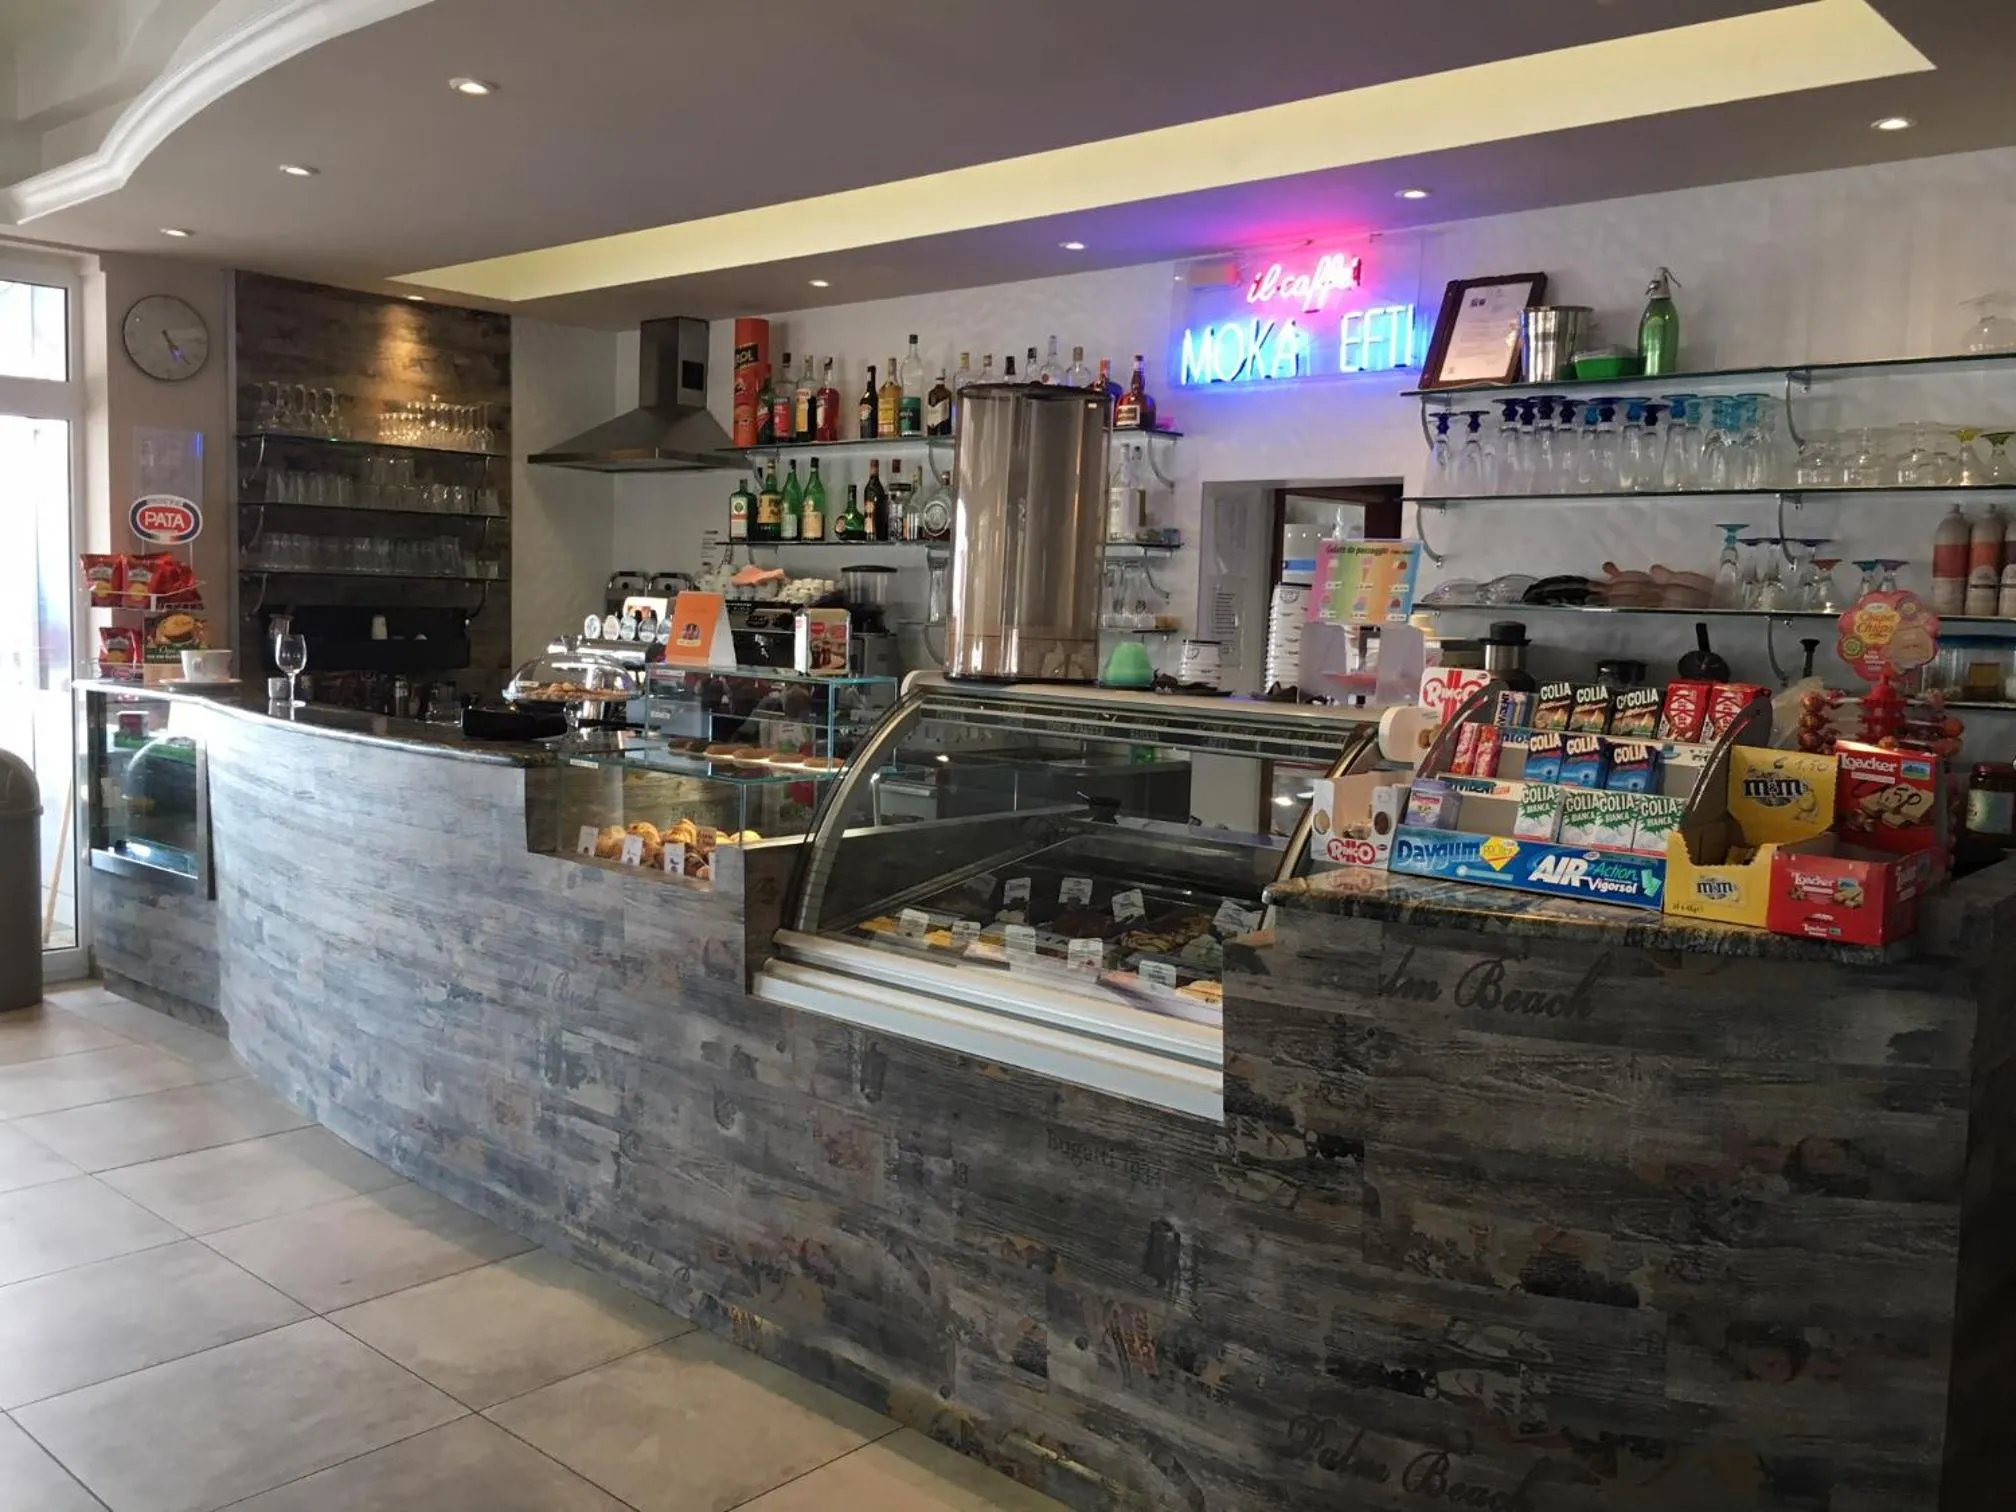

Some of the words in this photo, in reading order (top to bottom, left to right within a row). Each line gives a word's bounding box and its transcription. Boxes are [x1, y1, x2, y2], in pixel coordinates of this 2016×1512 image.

[1181, 318, 1302, 386] MOKA
[1339, 303, 1416, 373] EFTI
[144, 511, 186, 530] PATA
[1837, 752, 1898, 773] Loacker
[1397, 839, 1481, 870] Daygum
[1527, 854, 1588, 888] AIR
[1592, 861, 1638, 881] Action
[1584, 876, 1638, 895] Vigorsol
[1454, 951, 1611, 1020] Beach
[1284, 1414, 1392, 1484] Palm
